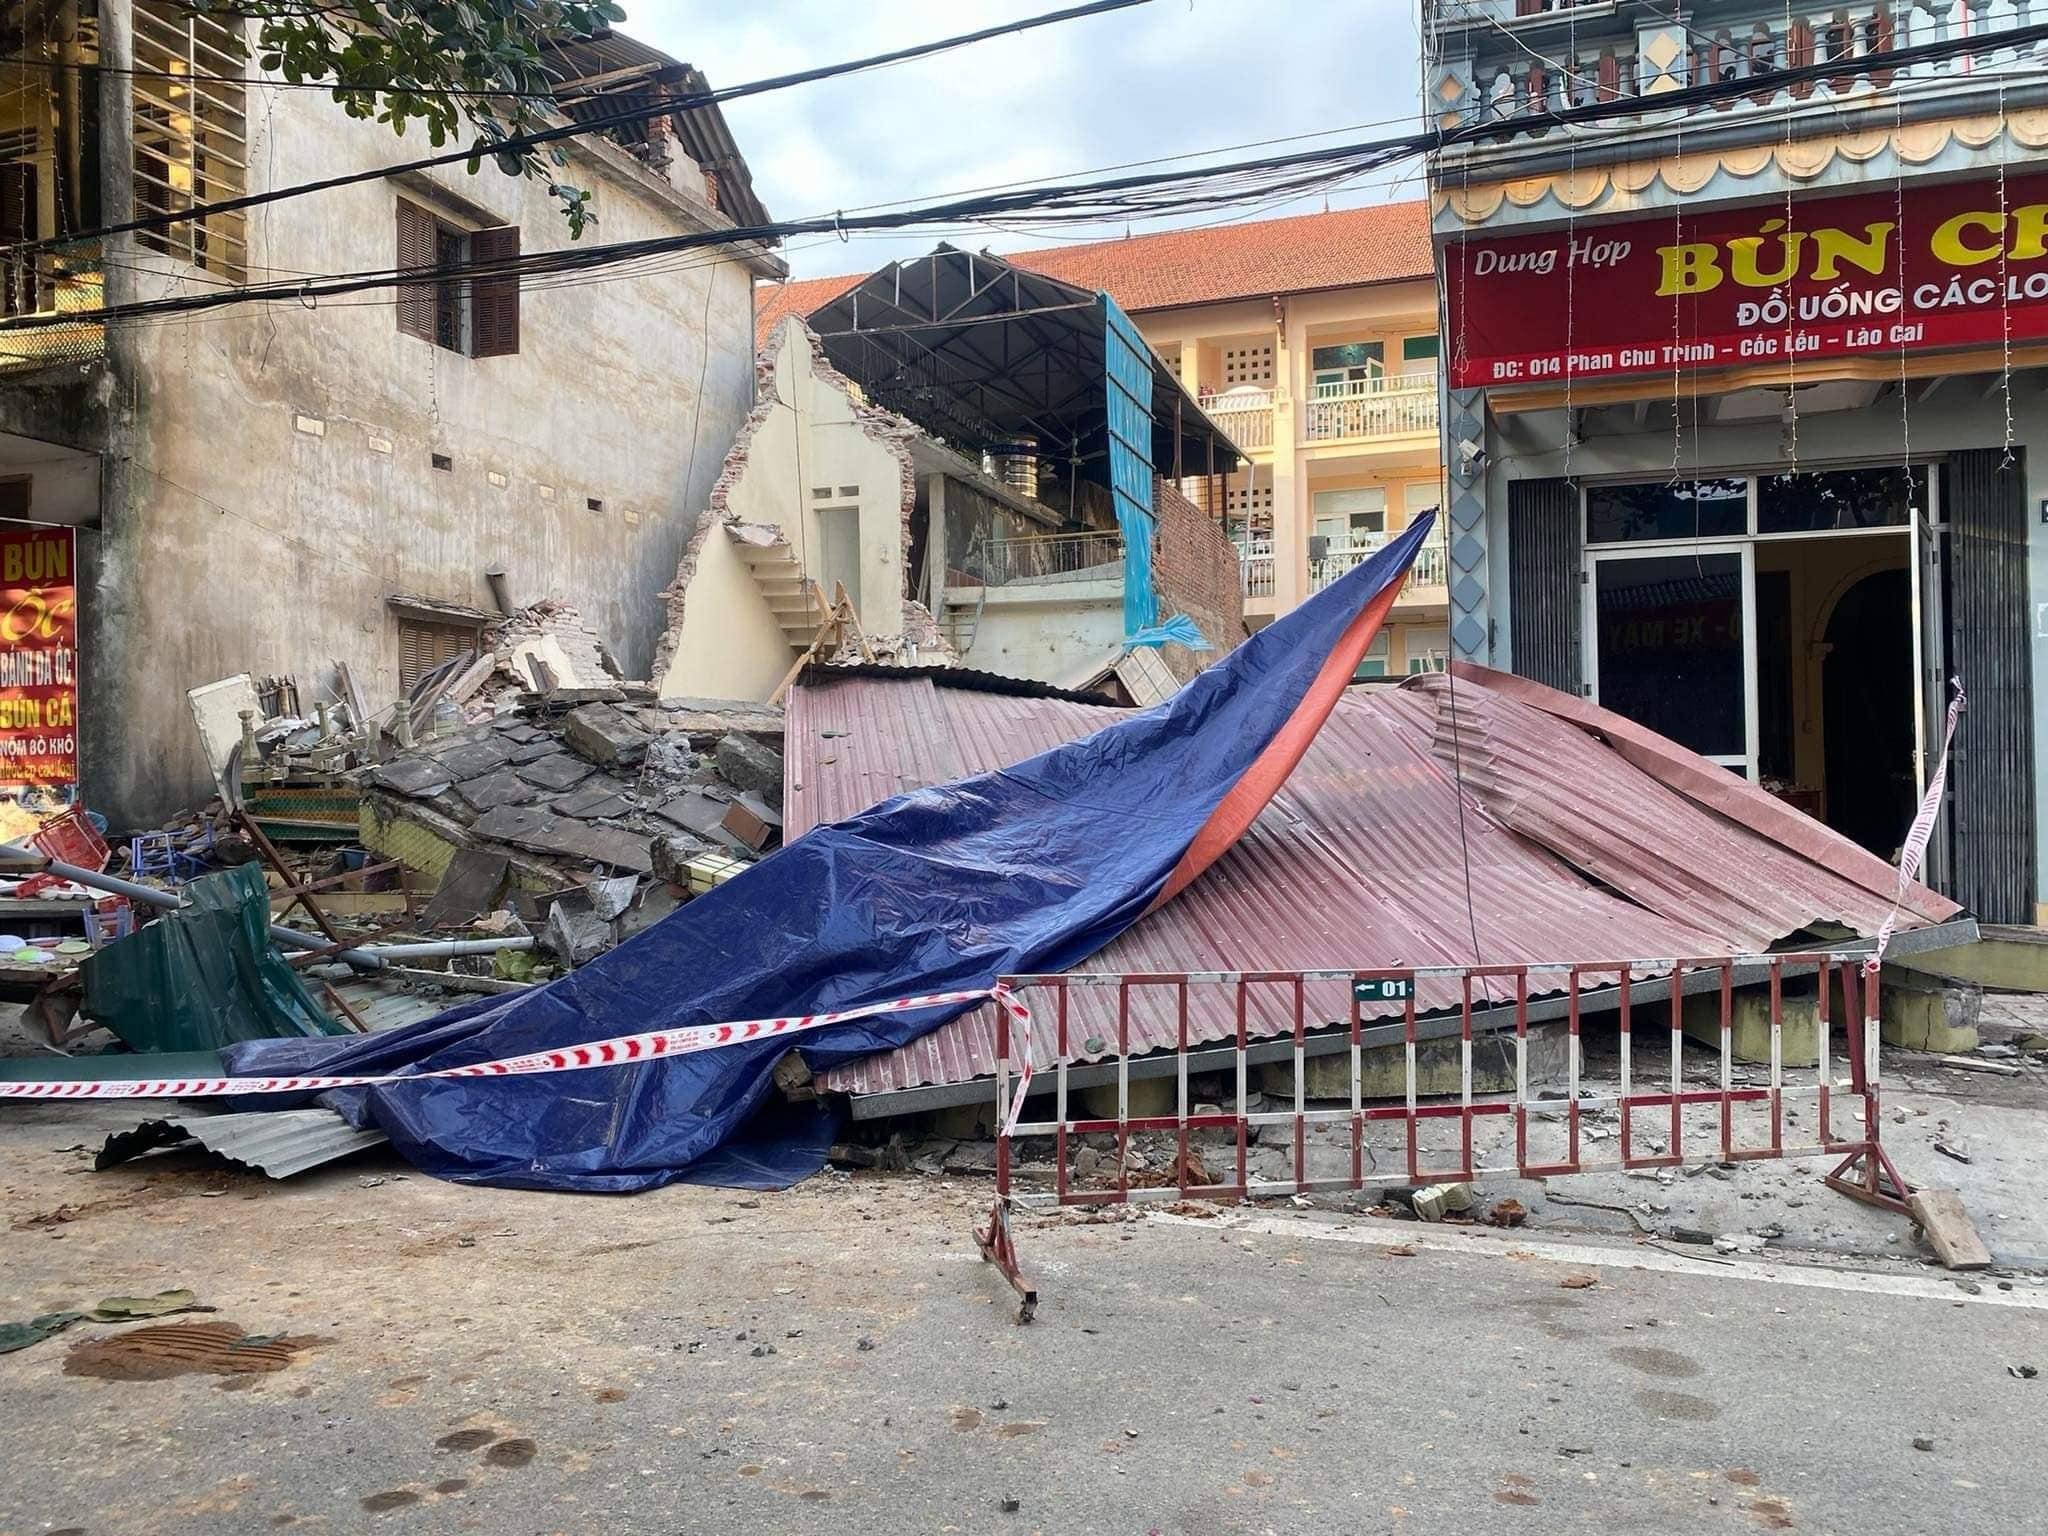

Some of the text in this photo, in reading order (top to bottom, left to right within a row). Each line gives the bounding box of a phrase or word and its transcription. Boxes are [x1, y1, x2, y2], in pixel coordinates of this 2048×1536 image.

[1474, 236, 1632, 276] Dung Hợp
[1655, 218, 1895, 297] BÚN
[1736, 286, 1788, 327] ĐỒ
[1799, 281, 1902, 321] UỐNG
[1913, 273, 1996, 309] CÁC
[1493, 360, 1524, 379] ĐC:
[1530, 357, 1560, 376] 014
[1567, 352, 1613, 372] Phan
[1619, 348, 1656, 367] Chu
[1662, 343, 1715, 364] Trinh
[1740, 333, 1777, 356] Cốc
[1846, 327, 1882, 348] Lào
[1890, 323, 1924, 344] Cai
[4, 533, 67, 582] BÚN
[0, 644, 33, 688] BÁNH
[0, 691, 73, 729] BÚN CÁ
[29, 734, 46, 755] BÒ
[49, 733, 74, 755] KHÔ
[1382, 980, 1406, 997] 01
